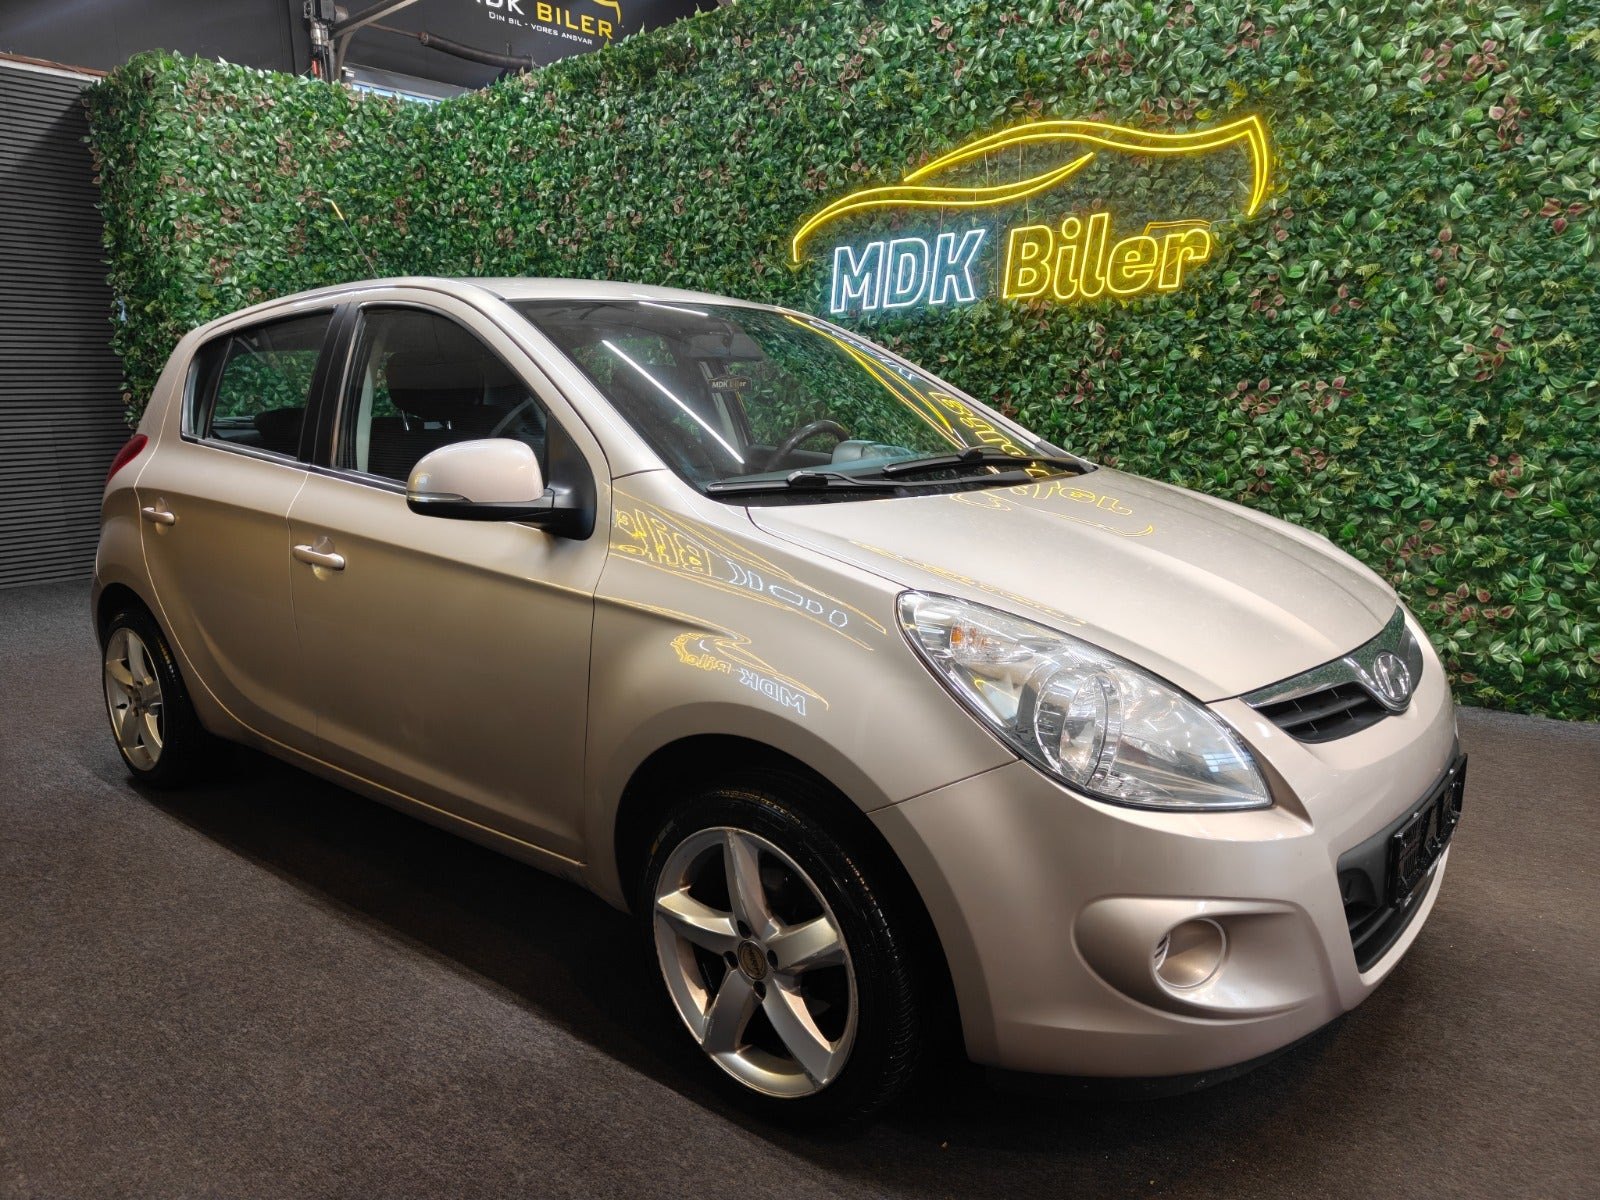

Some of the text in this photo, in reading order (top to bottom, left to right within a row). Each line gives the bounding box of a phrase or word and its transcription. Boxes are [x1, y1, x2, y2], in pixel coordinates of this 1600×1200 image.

[488, 11, 506, 22] DIN
[508, 17, 522, 27] BIL
[531, 24, 559, 36] VORES
[561, 32, 593, 46] ANSVAR
[536, 1, 613, 40] BILER
[830, 212, 1211, 313] MDK Biler
